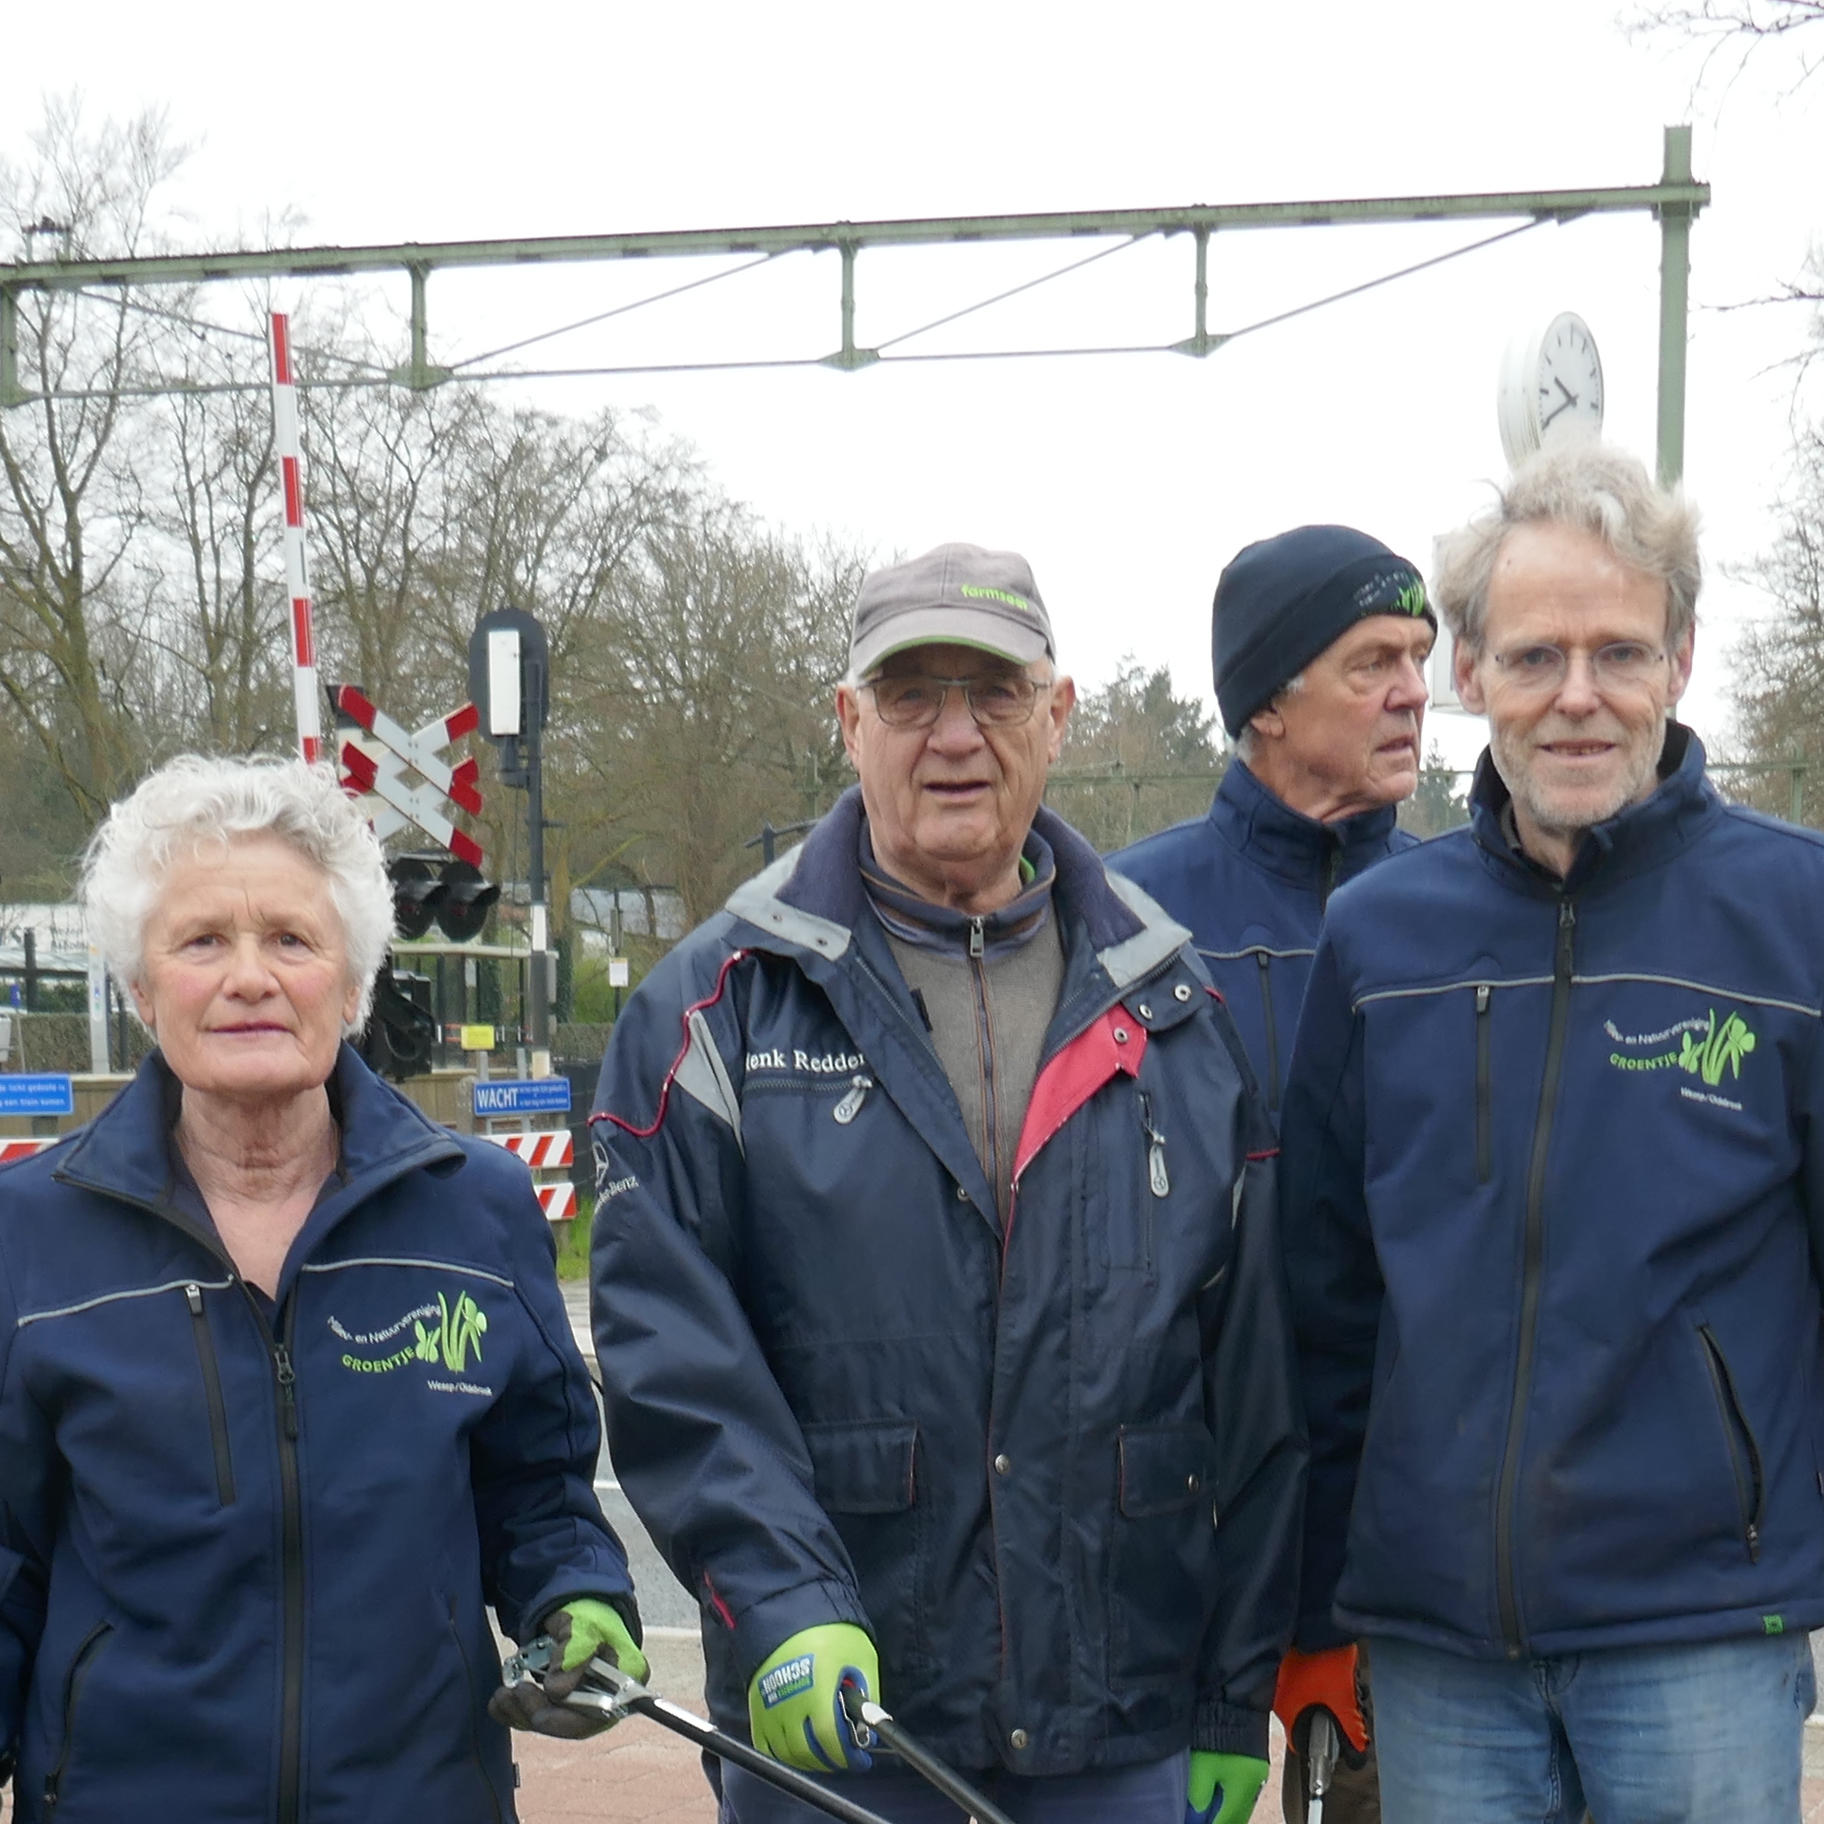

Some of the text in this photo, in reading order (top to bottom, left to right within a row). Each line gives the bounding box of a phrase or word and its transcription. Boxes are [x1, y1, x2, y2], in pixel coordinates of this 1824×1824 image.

[1609, 1051, 1678, 1071] GROENTJE
[477, 1087, 519, 1109] WACHT
[341, 1345, 416, 1374] GROENTJE
[762, 1657, 811, 1693] SCHOON
